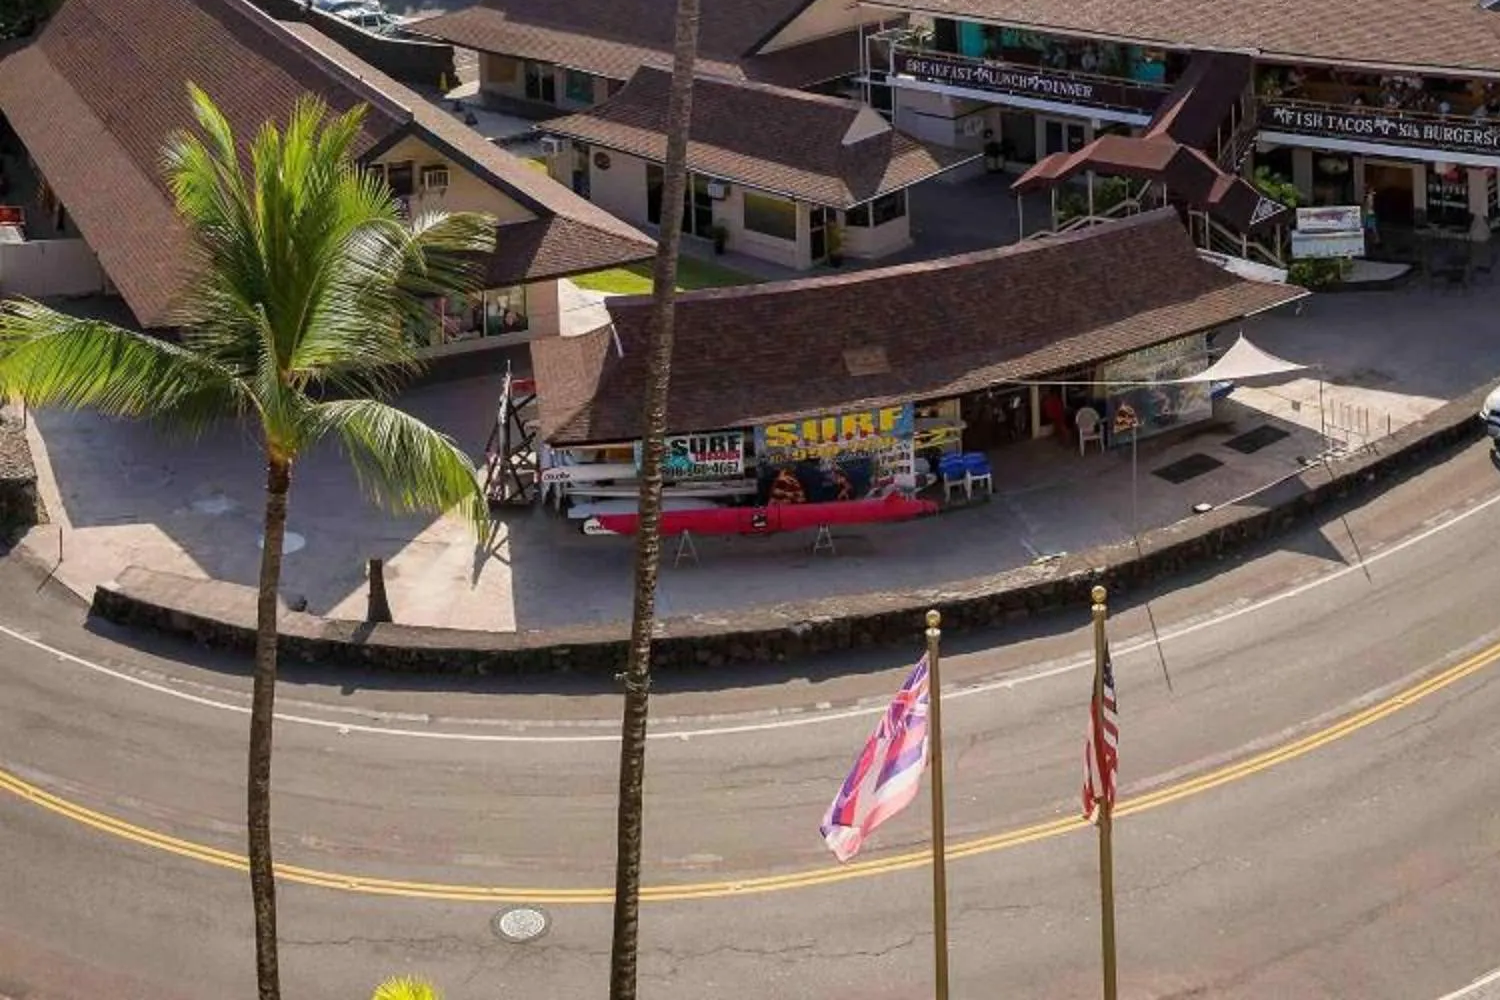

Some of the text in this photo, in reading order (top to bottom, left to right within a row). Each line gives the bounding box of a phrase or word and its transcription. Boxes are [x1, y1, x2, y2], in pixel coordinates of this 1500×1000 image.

[906, 58, 1093, 97] BREAKFAST LUNCH DINNER
[1284, 109, 1322, 128] FISH
[1327, 114, 1373, 133] TACOS
[1423, 124, 1493, 145] BURGERS
[766, 406, 903, 447] SURF
[671, 435, 741, 456] SURF
